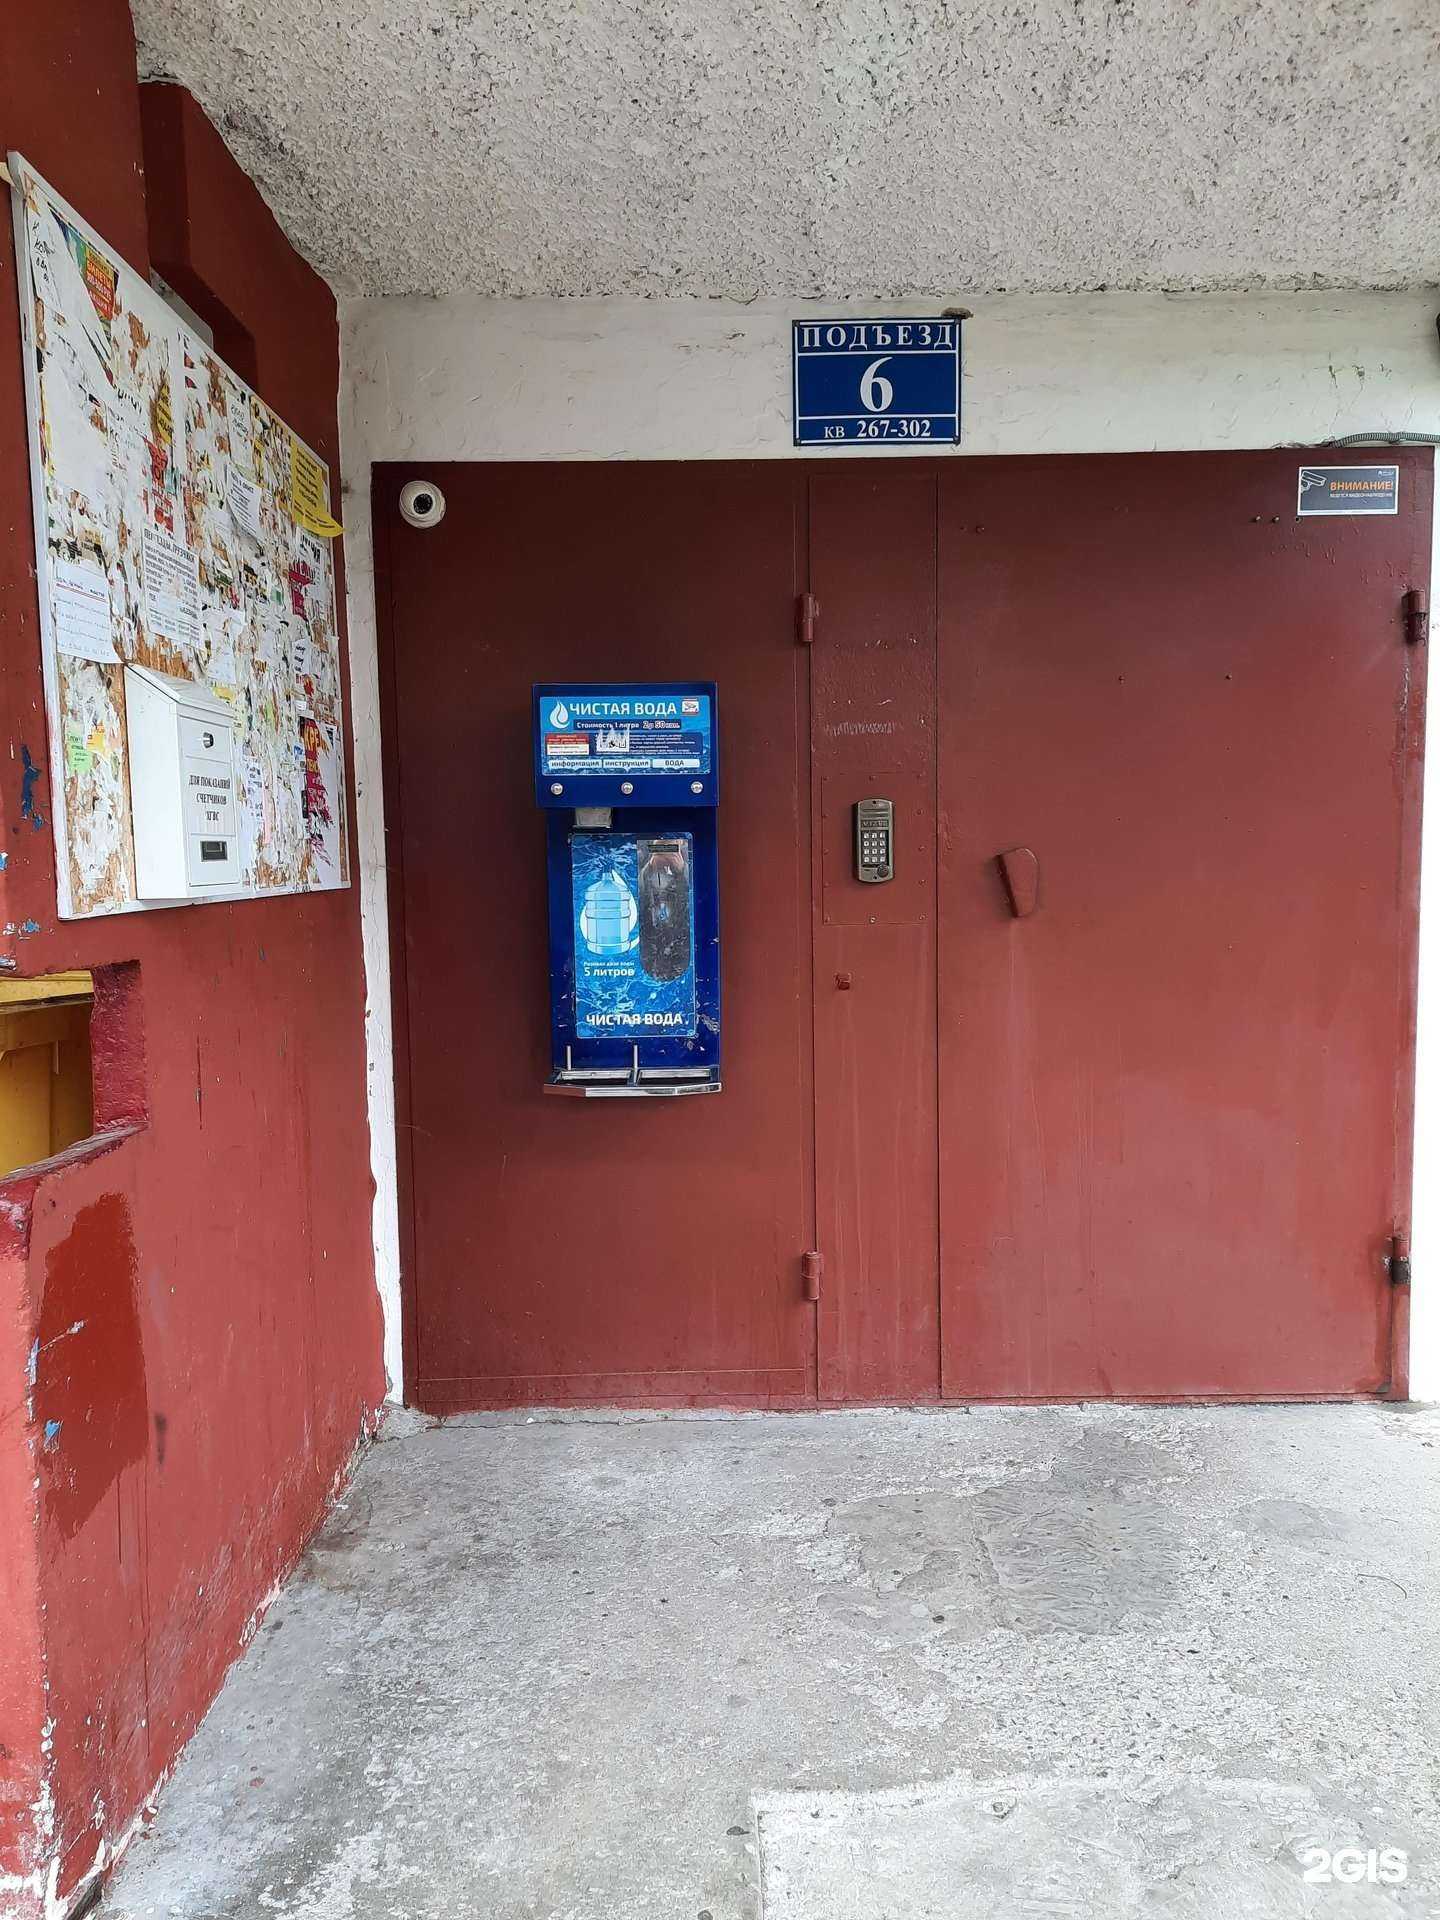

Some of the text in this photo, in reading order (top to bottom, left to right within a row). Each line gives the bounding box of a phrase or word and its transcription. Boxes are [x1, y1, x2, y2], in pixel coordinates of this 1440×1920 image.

[802, 325, 953, 351] ПОДЪЕЗД
[860, 356, 894, 412] 6
[857, 419, 931, 438] 267-302
[570, 702, 630, 715] ЧИСТАЯ
[634, 702, 677, 717] ВОДА
[551, 760, 600, 768] информация
[605, 761, 649, 769] инструкция
[584, 967, 635, 978] 5 литров
[586, 1013, 683, 1027] ЧИСТАЯ ВОДА
